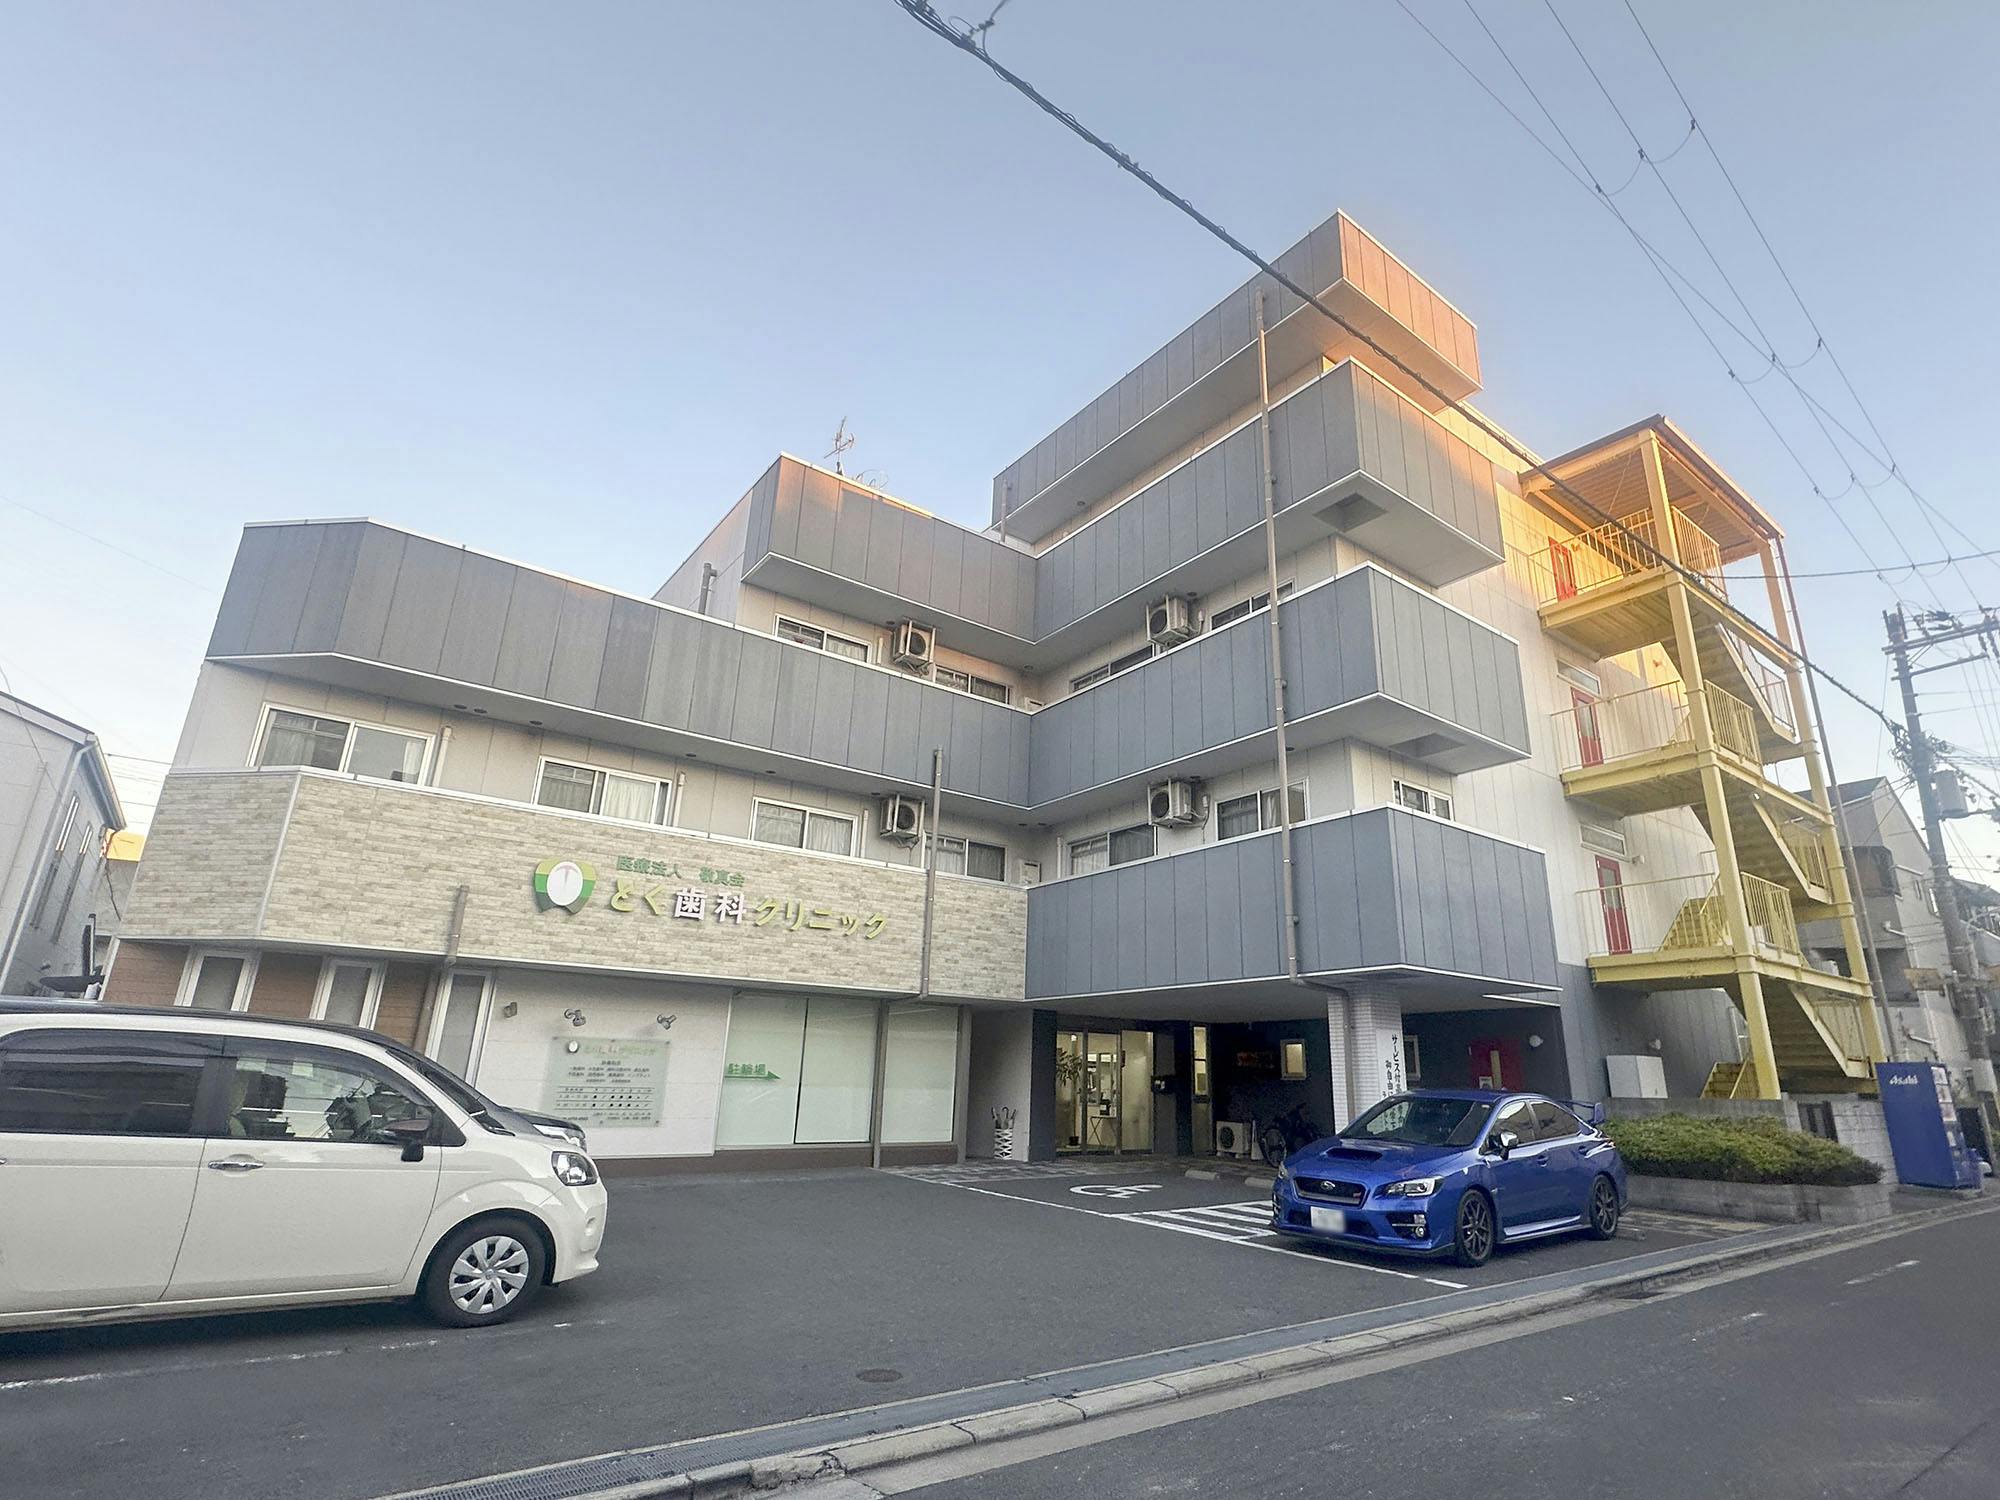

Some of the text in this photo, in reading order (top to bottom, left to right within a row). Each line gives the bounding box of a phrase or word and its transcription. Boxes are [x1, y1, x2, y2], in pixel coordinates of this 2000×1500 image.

[609, 878, 888, 939] とく歯科クリニック
